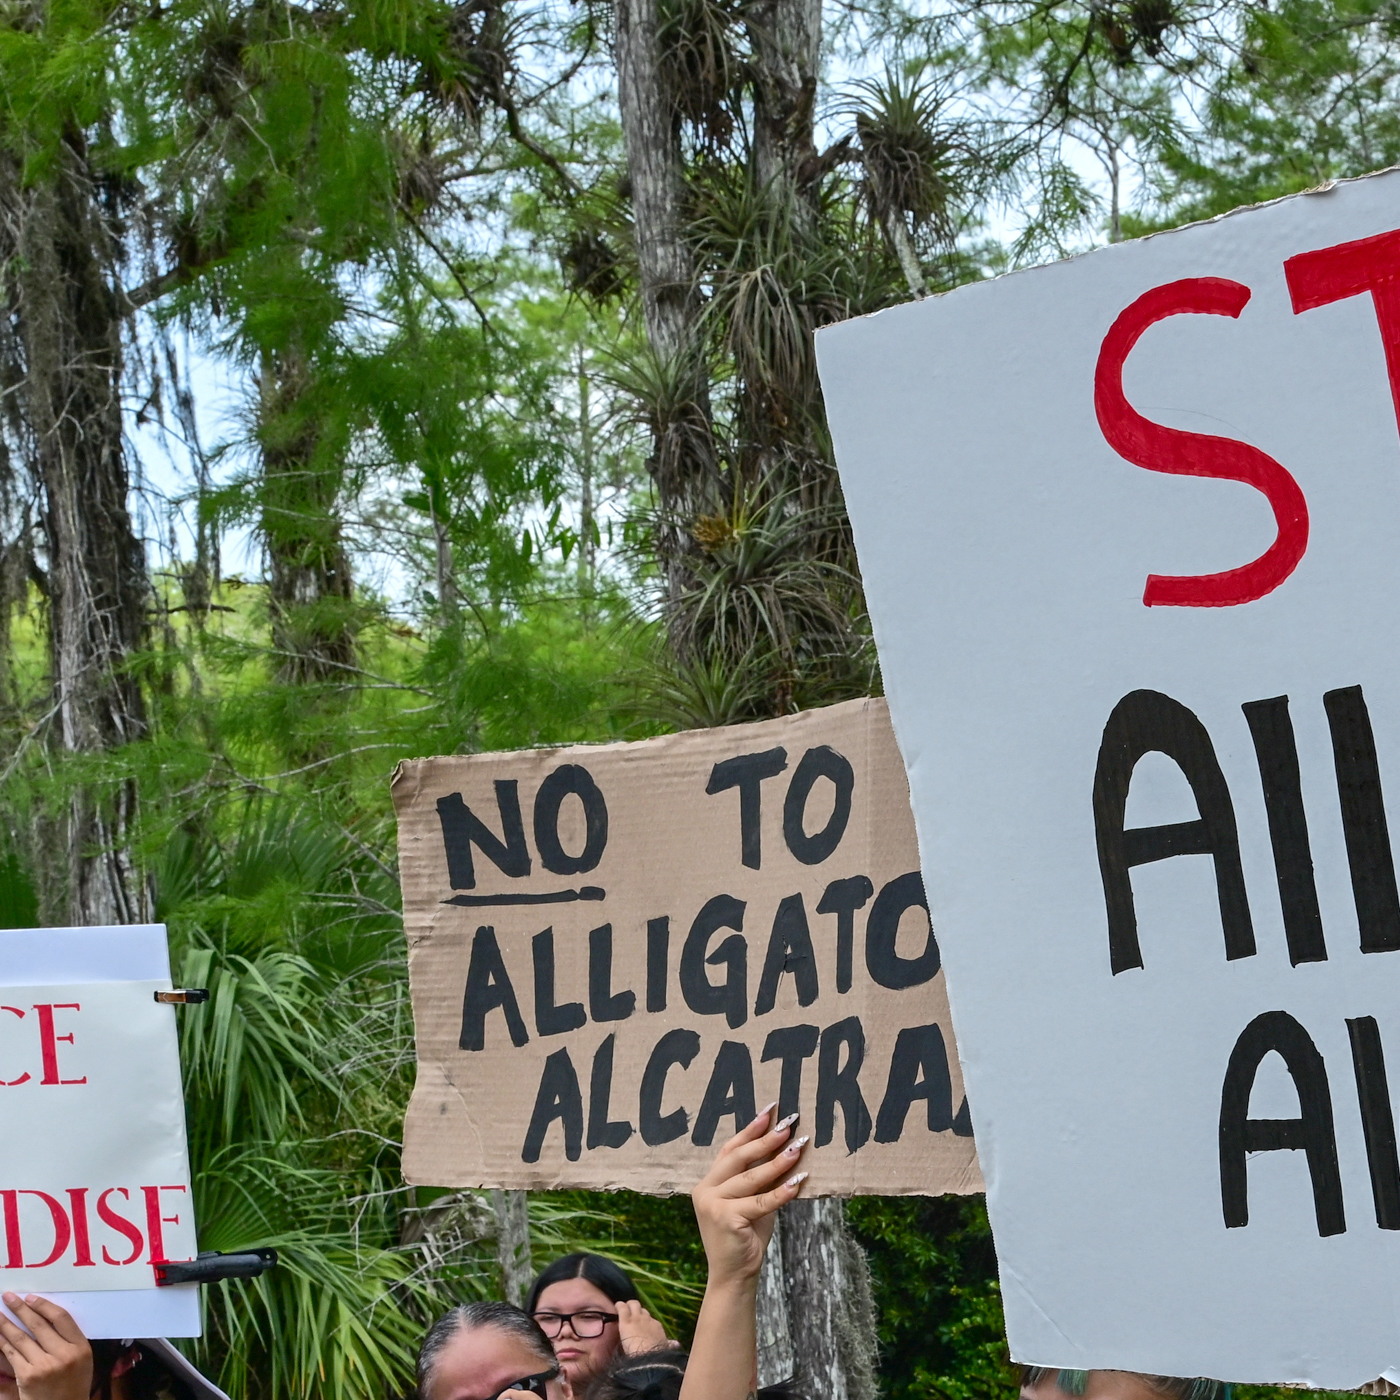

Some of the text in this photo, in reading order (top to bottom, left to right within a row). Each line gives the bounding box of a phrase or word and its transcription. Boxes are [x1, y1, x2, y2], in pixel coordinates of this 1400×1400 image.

[436, 744, 855, 890] NO TO
[521, 1016, 976, 1163] ALCATRA
